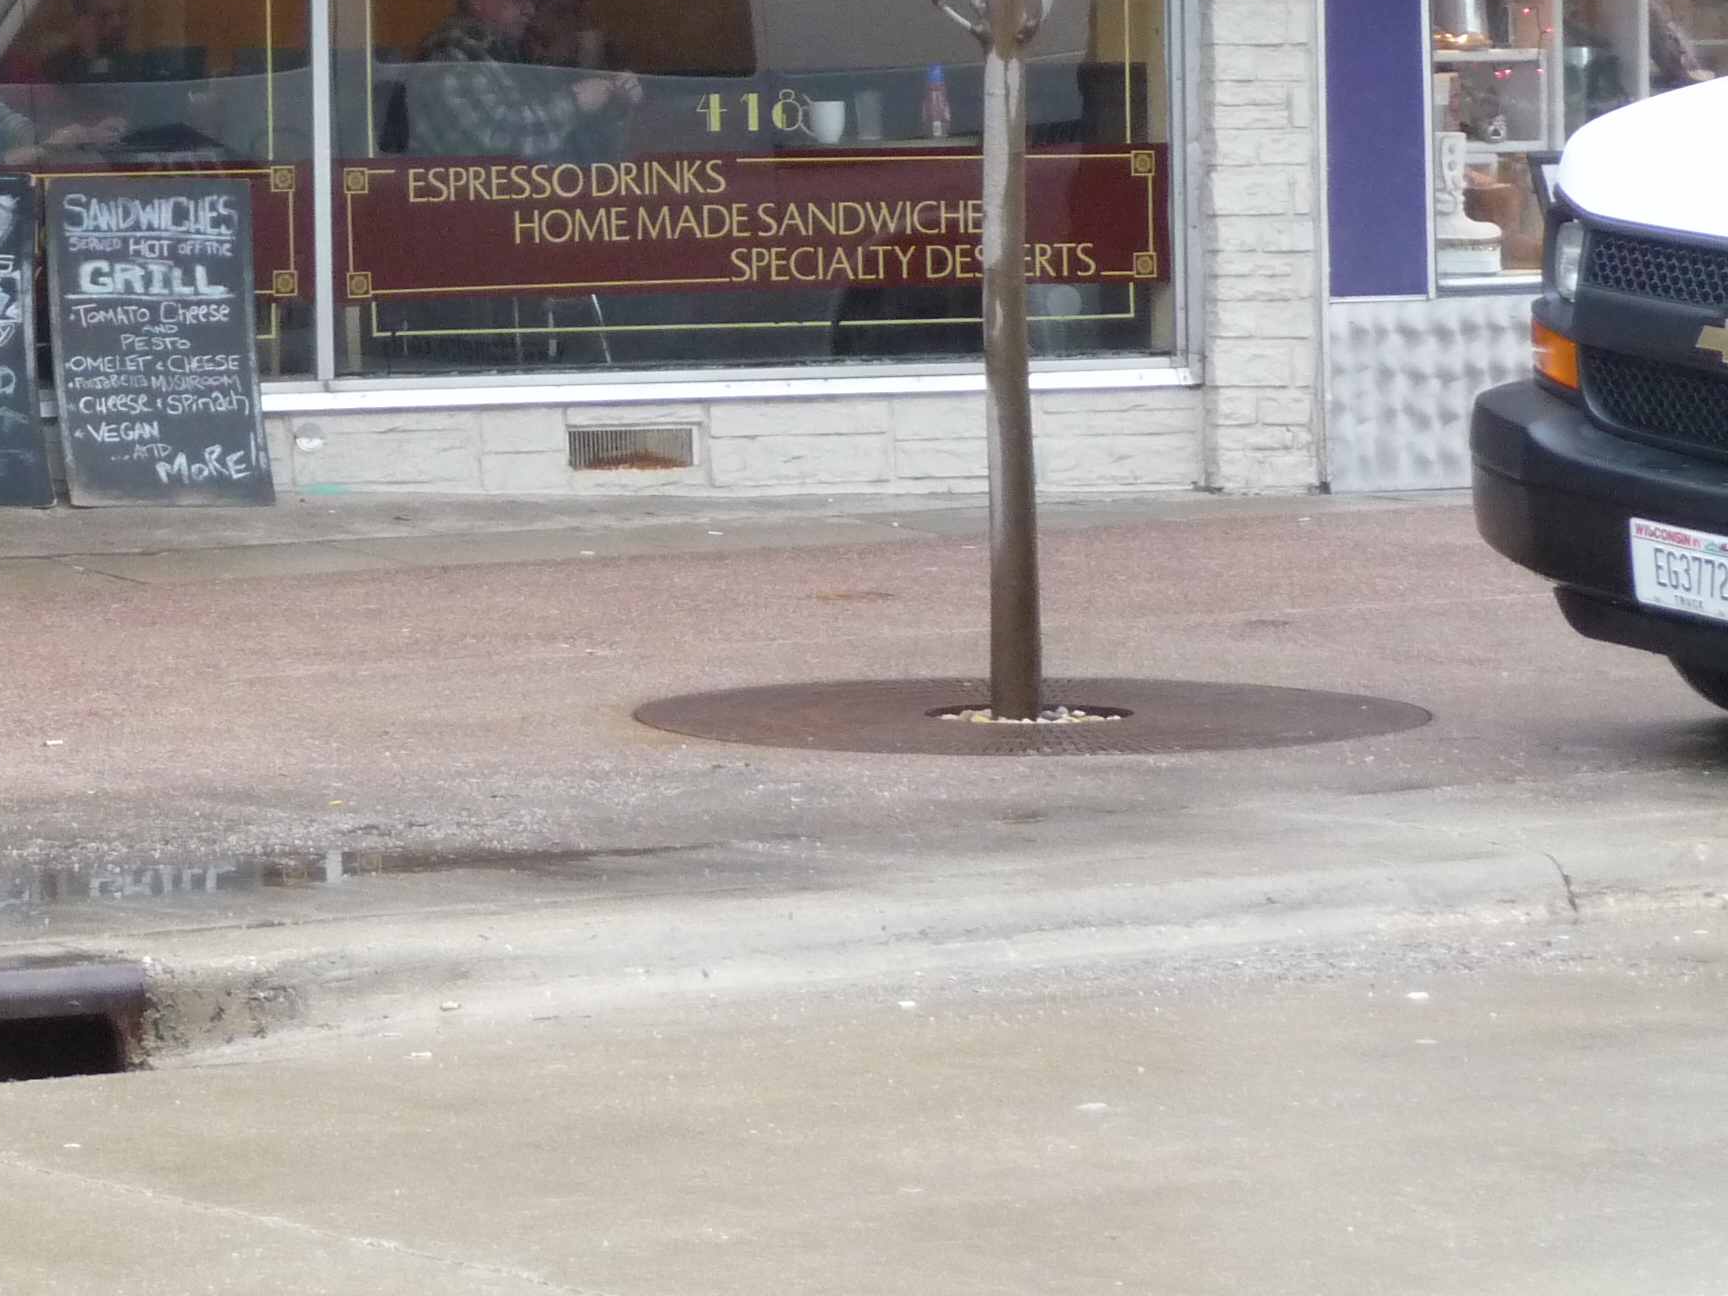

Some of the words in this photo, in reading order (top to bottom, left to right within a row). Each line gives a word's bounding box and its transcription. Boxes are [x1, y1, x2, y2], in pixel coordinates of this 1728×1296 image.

[408, 163, 584, 203] ESPRESSO
[591, 159, 727, 198] DRINKS
[63, 193, 239, 235] SANDWICHES
[758, 200, 984, 238] SANDWICHE
[129, 239, 172, 258] HOT
[78, 259, 229, 295] GRILL
[730, 245, 916, 282] SPECIALTY
[120, 334, 191, 351] PESTO
[167, 355, 240, 373] CHEESE
[151, 373, 243, 393] MUSHROOM
[86, 420, 161, 442] VEGAN
